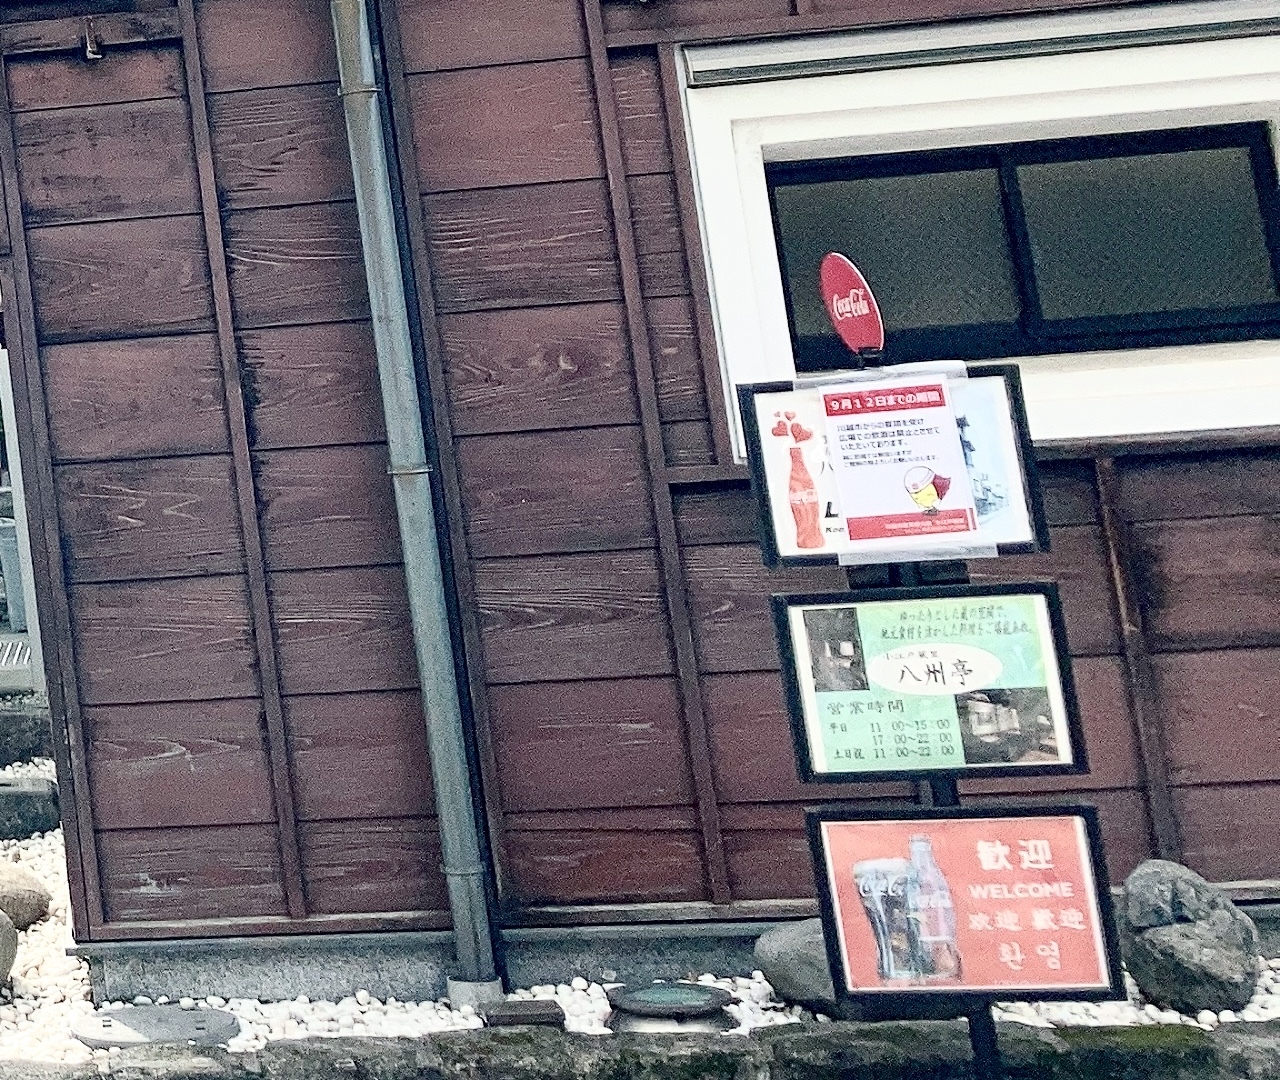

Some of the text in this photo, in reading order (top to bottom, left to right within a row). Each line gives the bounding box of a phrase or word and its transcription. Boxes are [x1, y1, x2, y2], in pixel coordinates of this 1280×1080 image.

[898, 658, 974, 686] 八州亭
[827, 699, 905, 715] 営業時間
[968, 882, 1075, 899] WELCOME
[998, 940, 1062, 970] 환영
